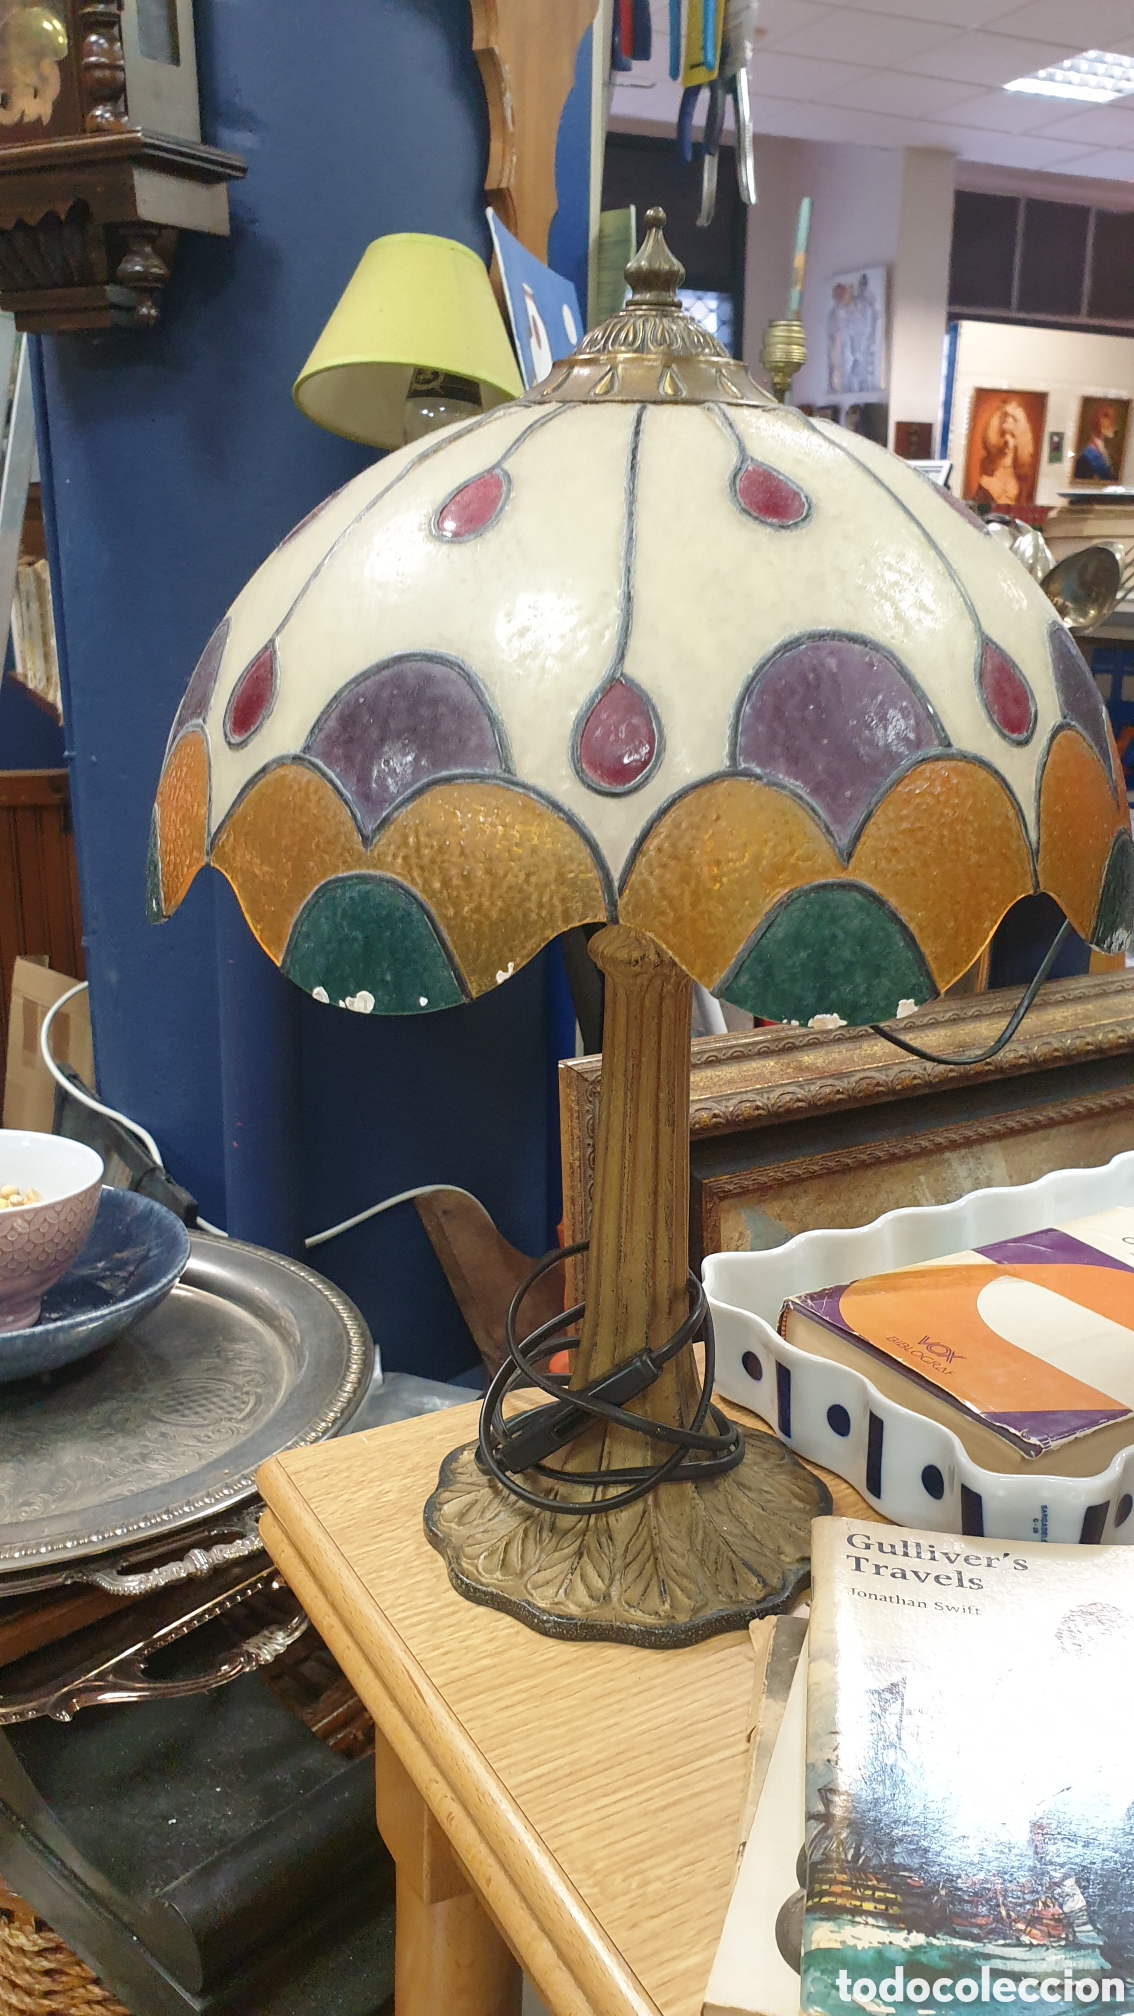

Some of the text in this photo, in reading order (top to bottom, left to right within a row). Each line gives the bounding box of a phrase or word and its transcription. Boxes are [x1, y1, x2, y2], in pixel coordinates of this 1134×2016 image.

[885, 1336, 957, 1377] BIBLOGRAF
[917, 1334, 967, 1364] VOX
[846, 1533, 1029, 1571] Gulliver's
[846, 1554, 984, 1590] Travels
[847, 1587, 982, 1616] Jonathan Swift
